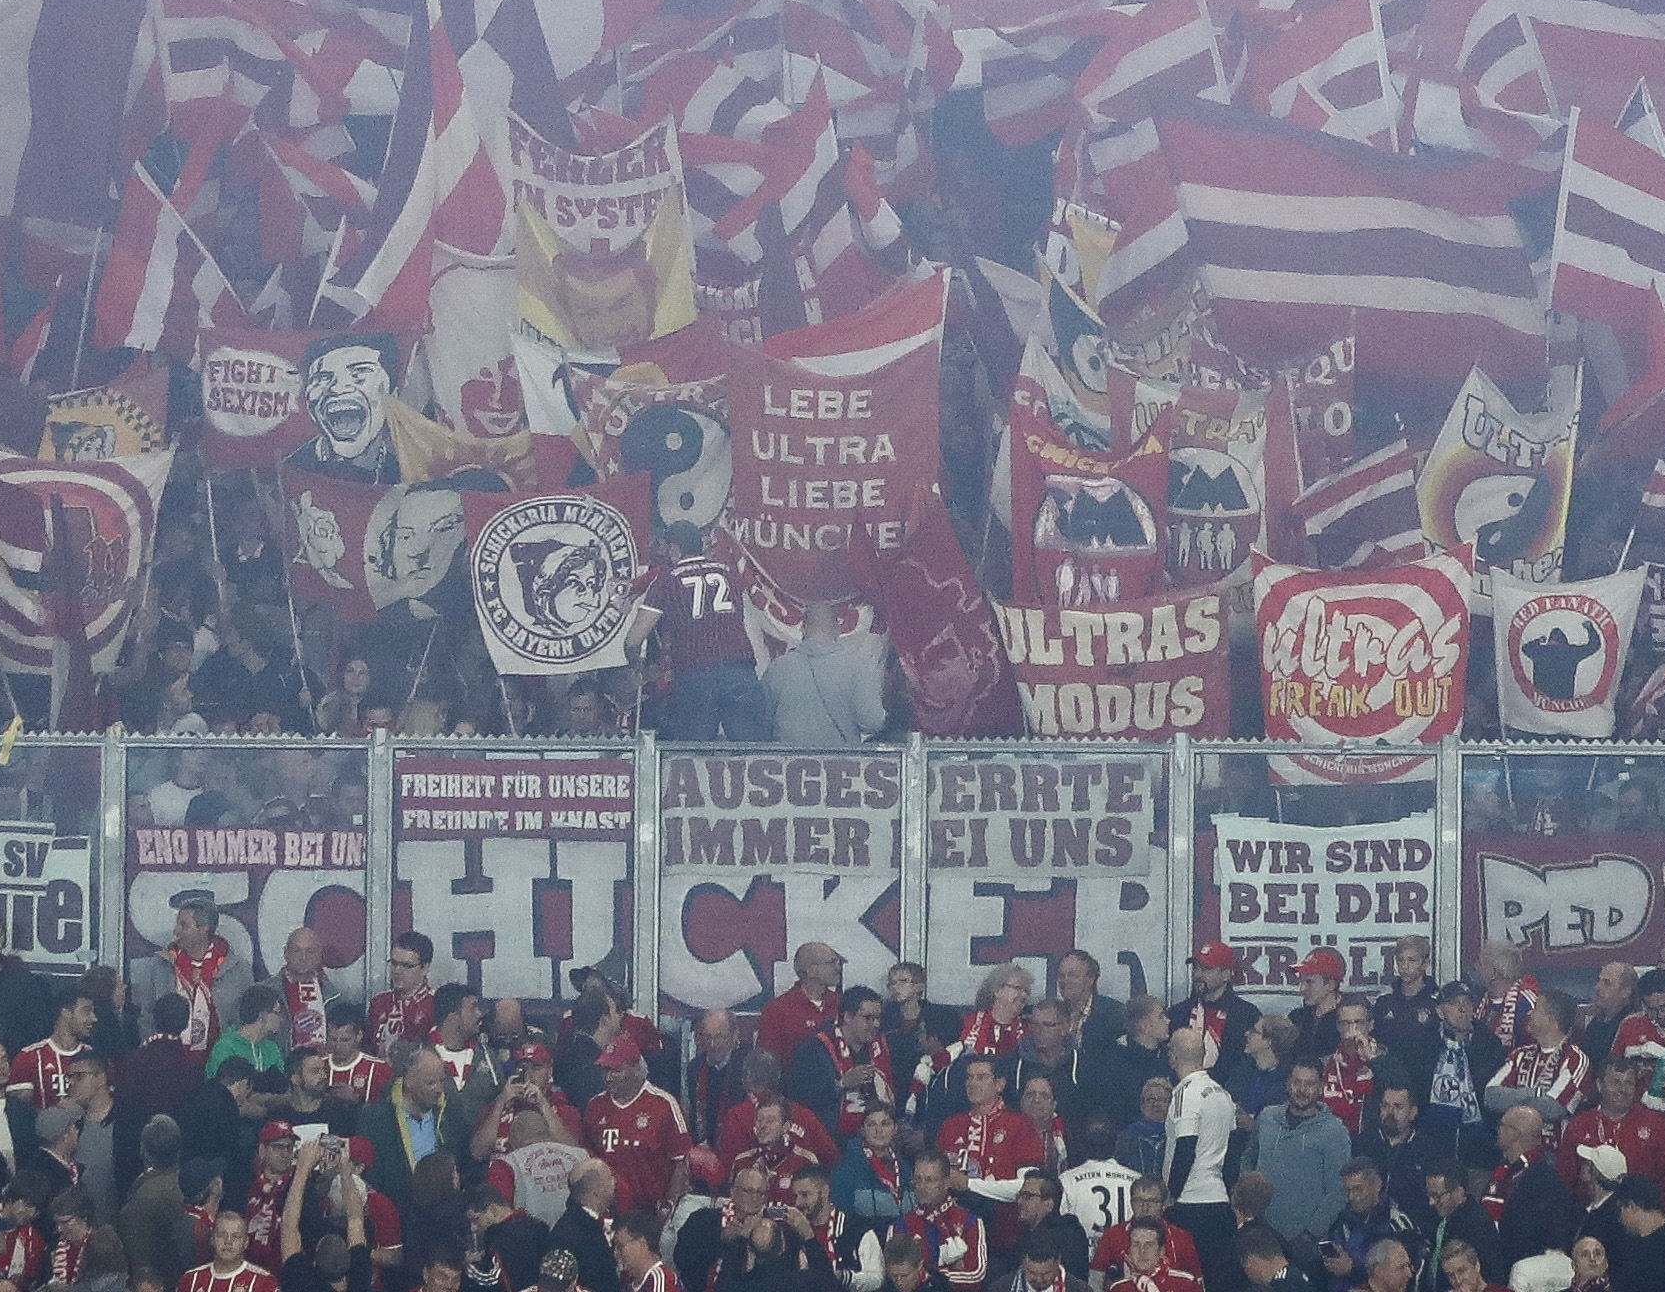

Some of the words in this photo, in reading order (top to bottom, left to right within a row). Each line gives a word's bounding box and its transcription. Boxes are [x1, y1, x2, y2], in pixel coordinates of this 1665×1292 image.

[208, 359, 278, 386] FIGHT
[207, 386, 292, 419] SEXISM
[764, 383, 874, 421] LEBE
[750, 429, 897, 465] ULTRA
[761, 475, 887, 509] LIEBE
[480, 504, 558, 574] SCHICKERIA
[681, 573, 733, 620] 72
[486, 596, 508, 624] FC
[502, 619, 576, 658] BAYERN
[578, 607, 622, 649] ULTR
[1268, 679, 1372, 719] FREAK
[1393, 676, 1453, 718] OUT
[400, 774, 496, 800] FREIHEIT
[500, 769, 543, 799] FÜR
[547, 774, 632, 800] UNSERE
[514, 810, 544, 831] IM
[3, 839, 53, 880] SV
[196, 831, 277, 868] IMMER
[283, 831, 324, 867] BEI
[330, 831, 368, 867] UN
[663, 816, 871, 868] IMMER
[1010, 816, 1135, 868] UNS
[1226, 838, 1314, 875] WIR
[1325, 837, 1433, 873] SIND
[1228, 882, 1320, 925] BEI
[1336, 881, 1431, 924] DIR
[1091, 1185, 1125, 1231] 31
